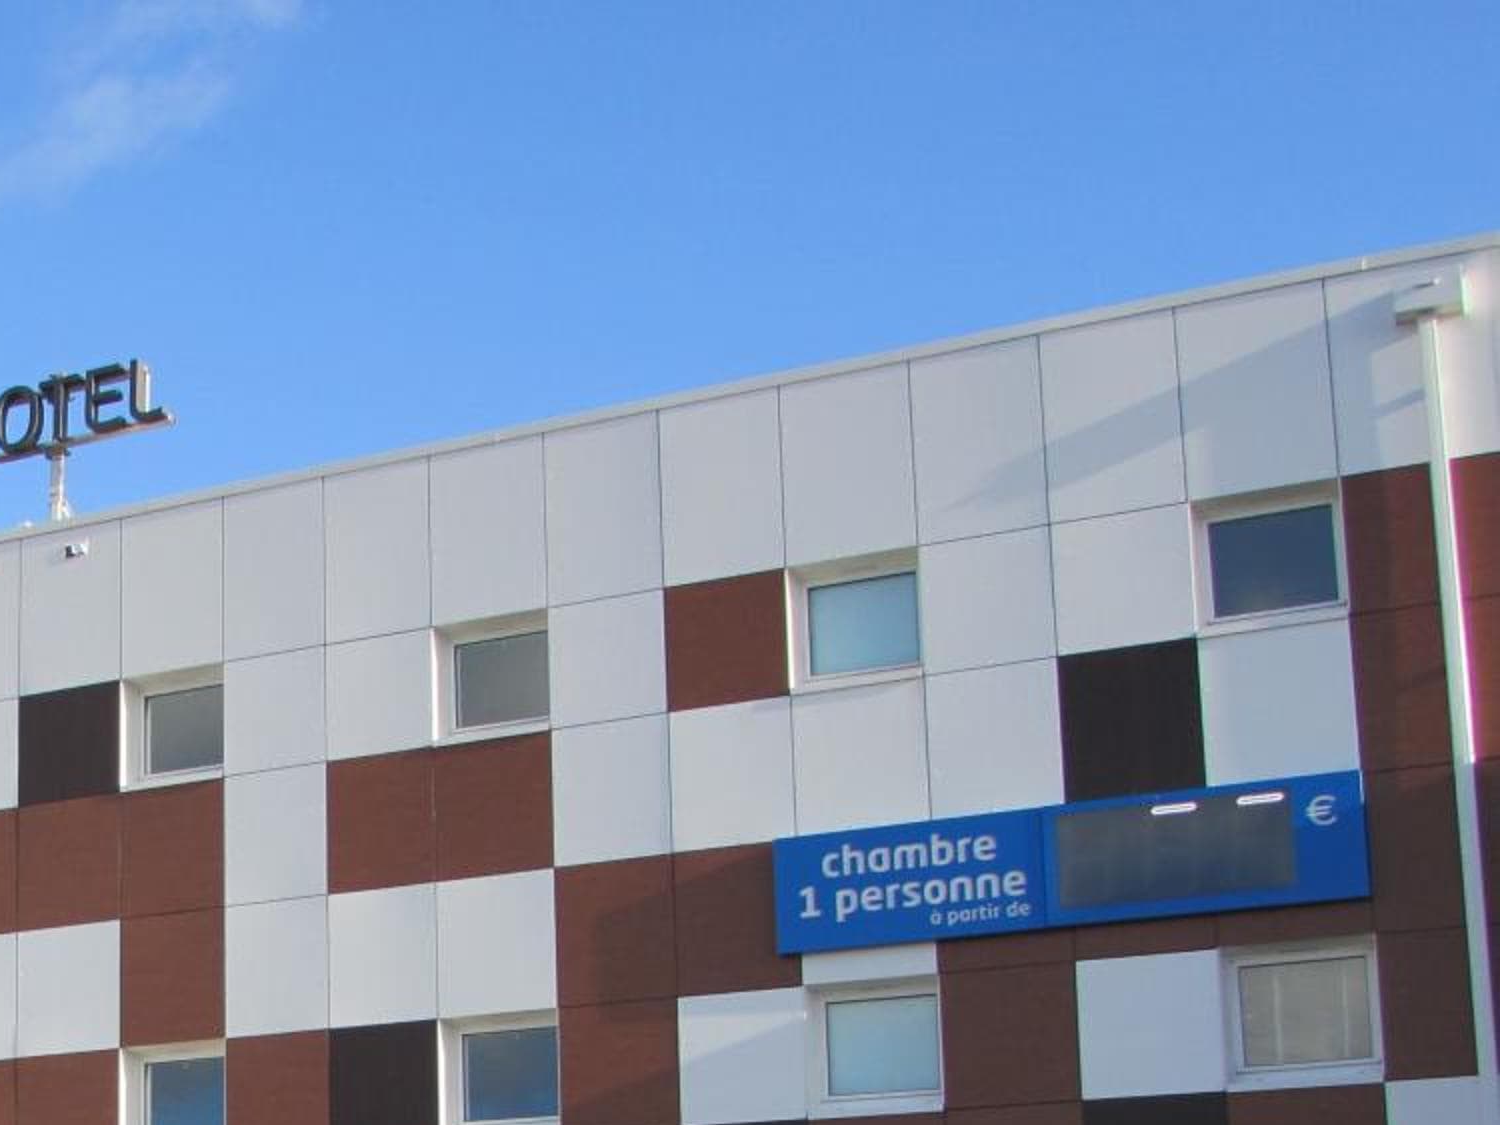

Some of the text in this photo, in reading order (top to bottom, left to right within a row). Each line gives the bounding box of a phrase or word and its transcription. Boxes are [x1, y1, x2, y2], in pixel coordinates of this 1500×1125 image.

[1306, 795, 1338, 826] €
[821, 834, 997, 879] chambre
[800, 869, 1027, 922] 1 personne
[948, 904, 1000, 926] partir
[1005, 900, 1031, 917] de
